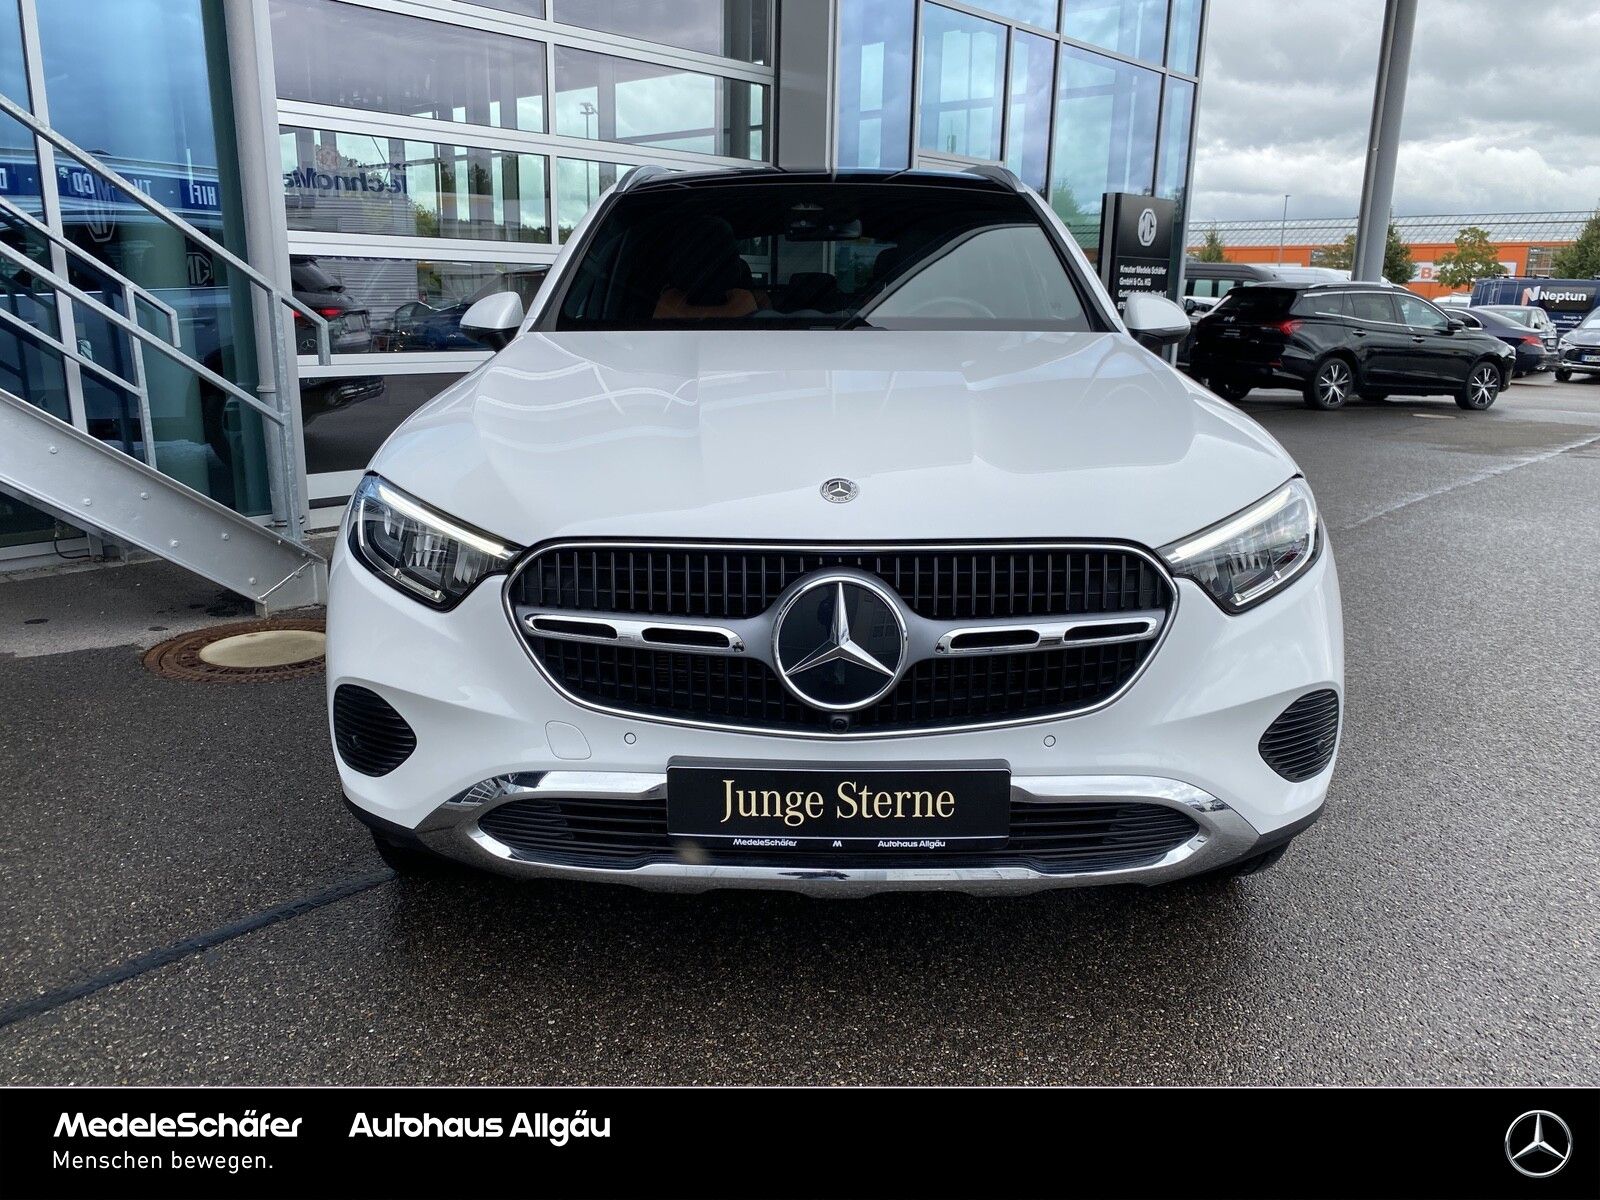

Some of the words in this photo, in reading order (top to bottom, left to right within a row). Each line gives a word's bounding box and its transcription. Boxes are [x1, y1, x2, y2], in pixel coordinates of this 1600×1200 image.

[1119, 277, 1133, 286] GmbH
[1540, 291, 1587, 304] Neptun
[720, 779, 824, 827] Junge
[836, 781, 955, 819] Sterne
[732, 838, 798, 847] MedeleSchäfer
[877, 840, 918, 848] Autohaus
[918, 839, 946, 850] Allgäu
